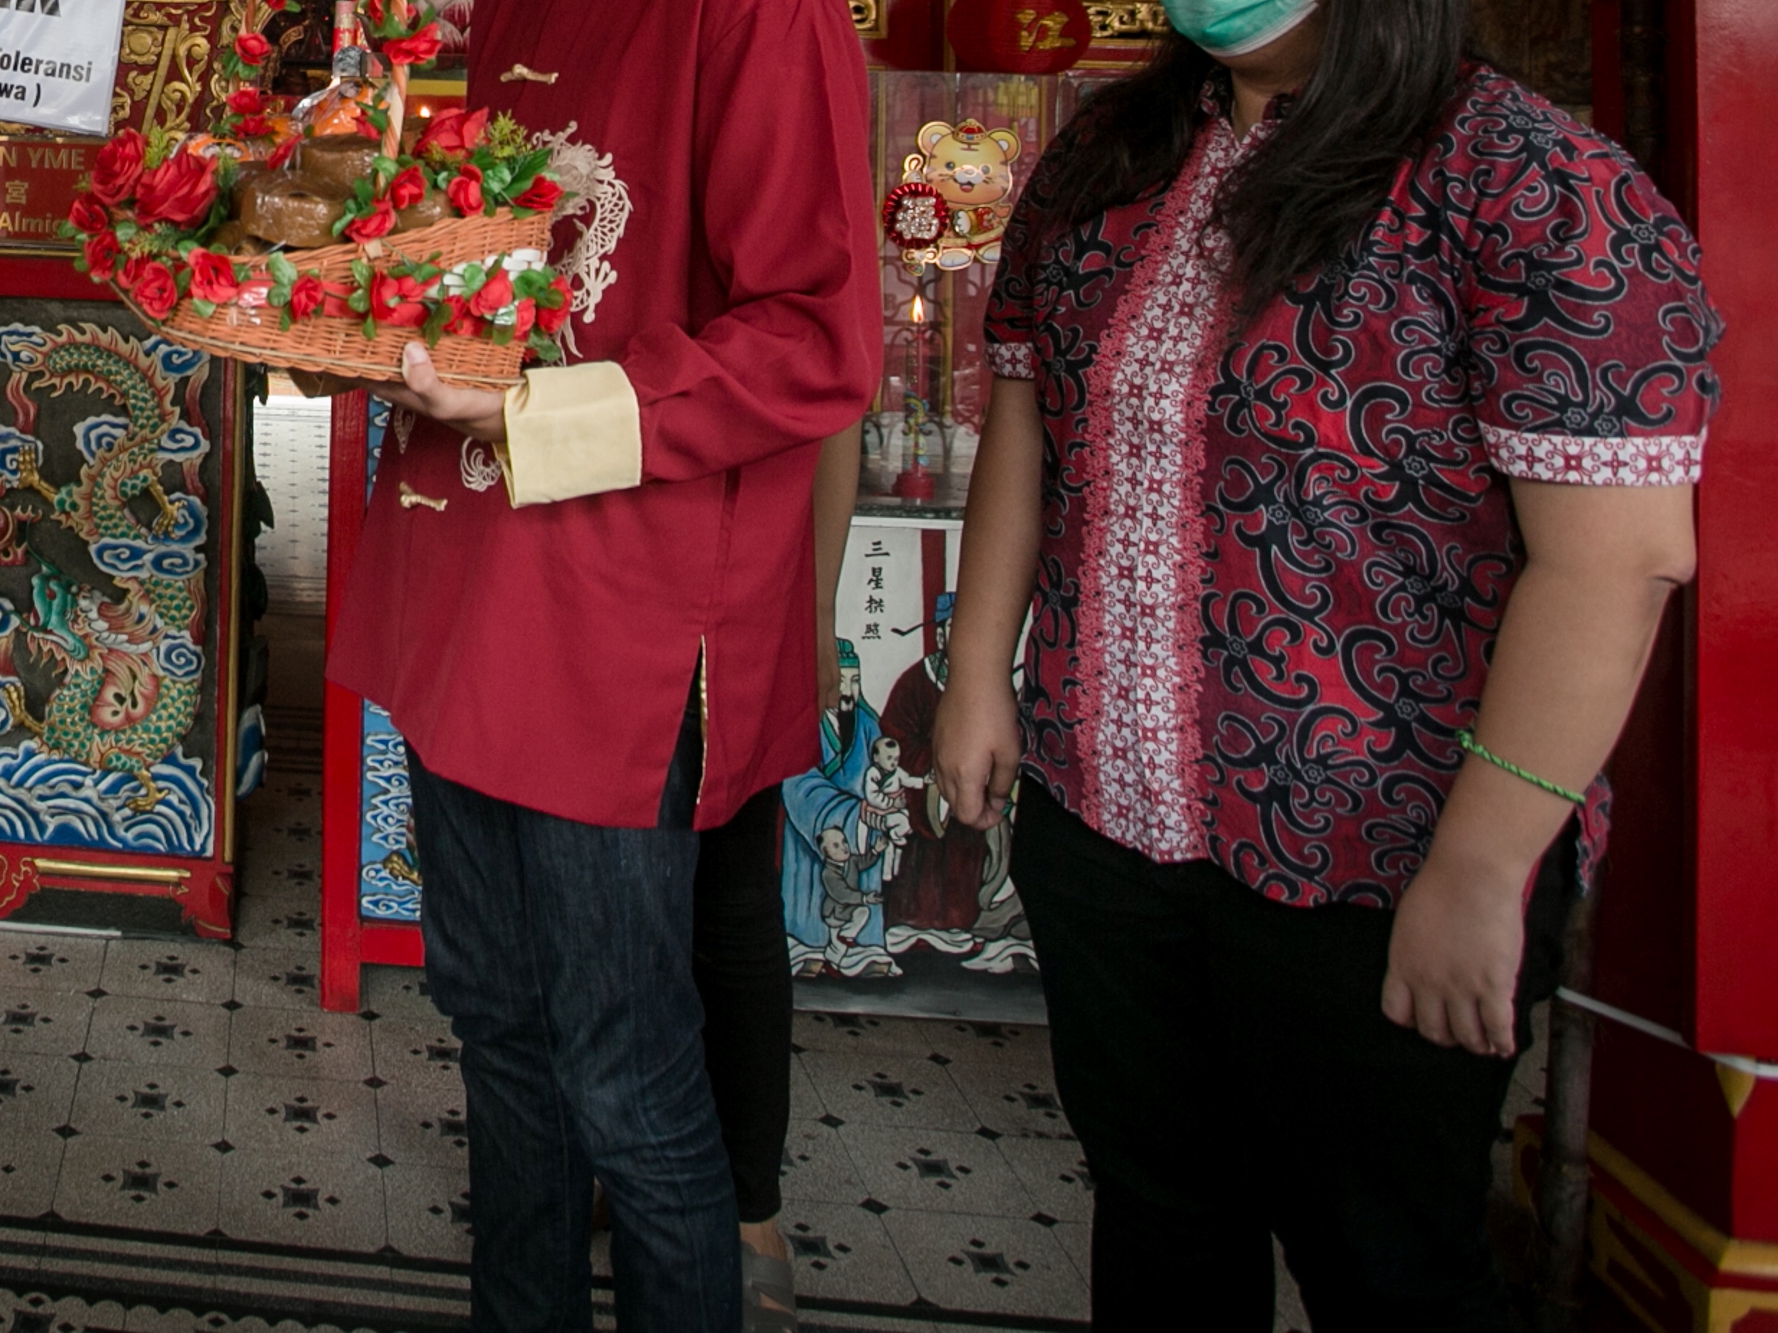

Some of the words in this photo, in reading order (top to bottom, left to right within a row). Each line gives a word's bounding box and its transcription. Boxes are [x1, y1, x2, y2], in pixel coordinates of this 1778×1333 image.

[27, 146, 86, 171] YME
[860, 540, 891, 643] 三星拱照
